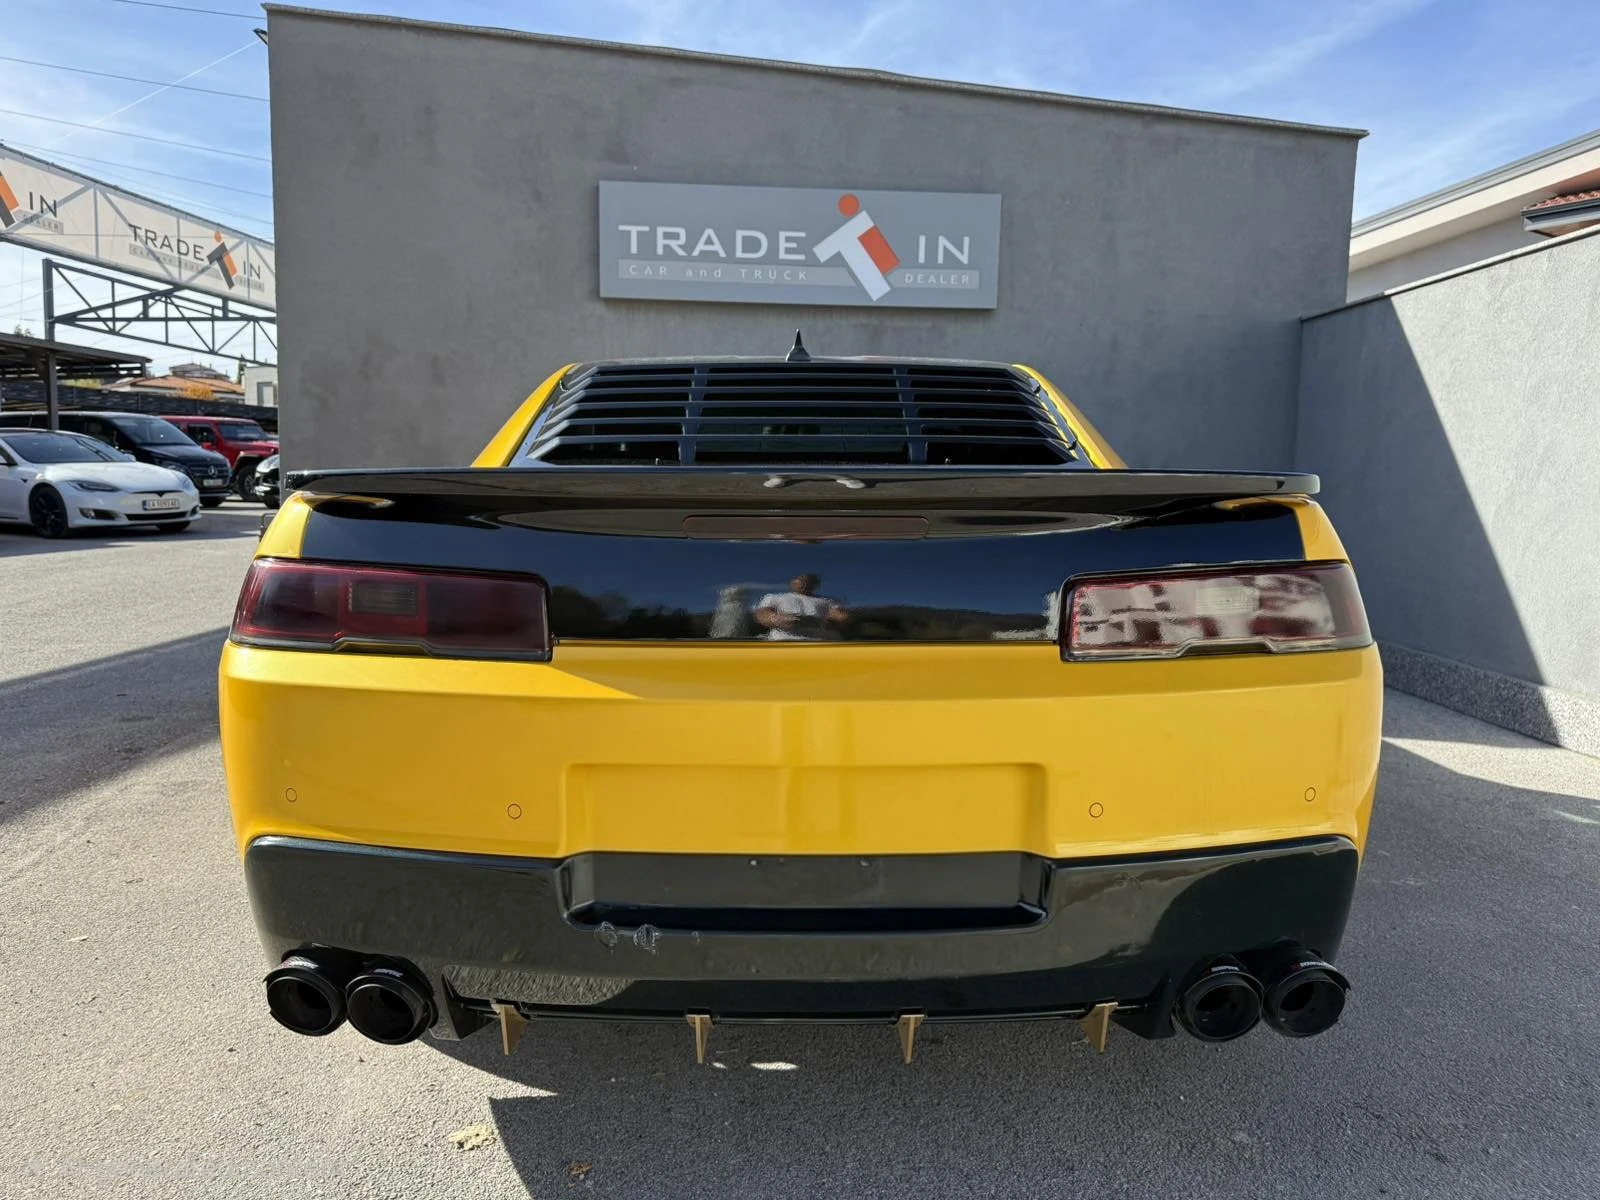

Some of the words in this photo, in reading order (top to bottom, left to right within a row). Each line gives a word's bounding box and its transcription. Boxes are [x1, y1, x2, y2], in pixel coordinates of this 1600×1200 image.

[29, 191, 57, 218] IN
[128, 223, 205, 262] TRADE
[243, 260, 261, 280] IN
[618, 225, 806, 261] TRADE
[917, 235, 970, 265] IN
[629, 264, 668, 276] CAR
[686, 268, 723, 278] and
[740, 269, 808, 280] TRUCK
[905, 274, 970, 285] DEALER
